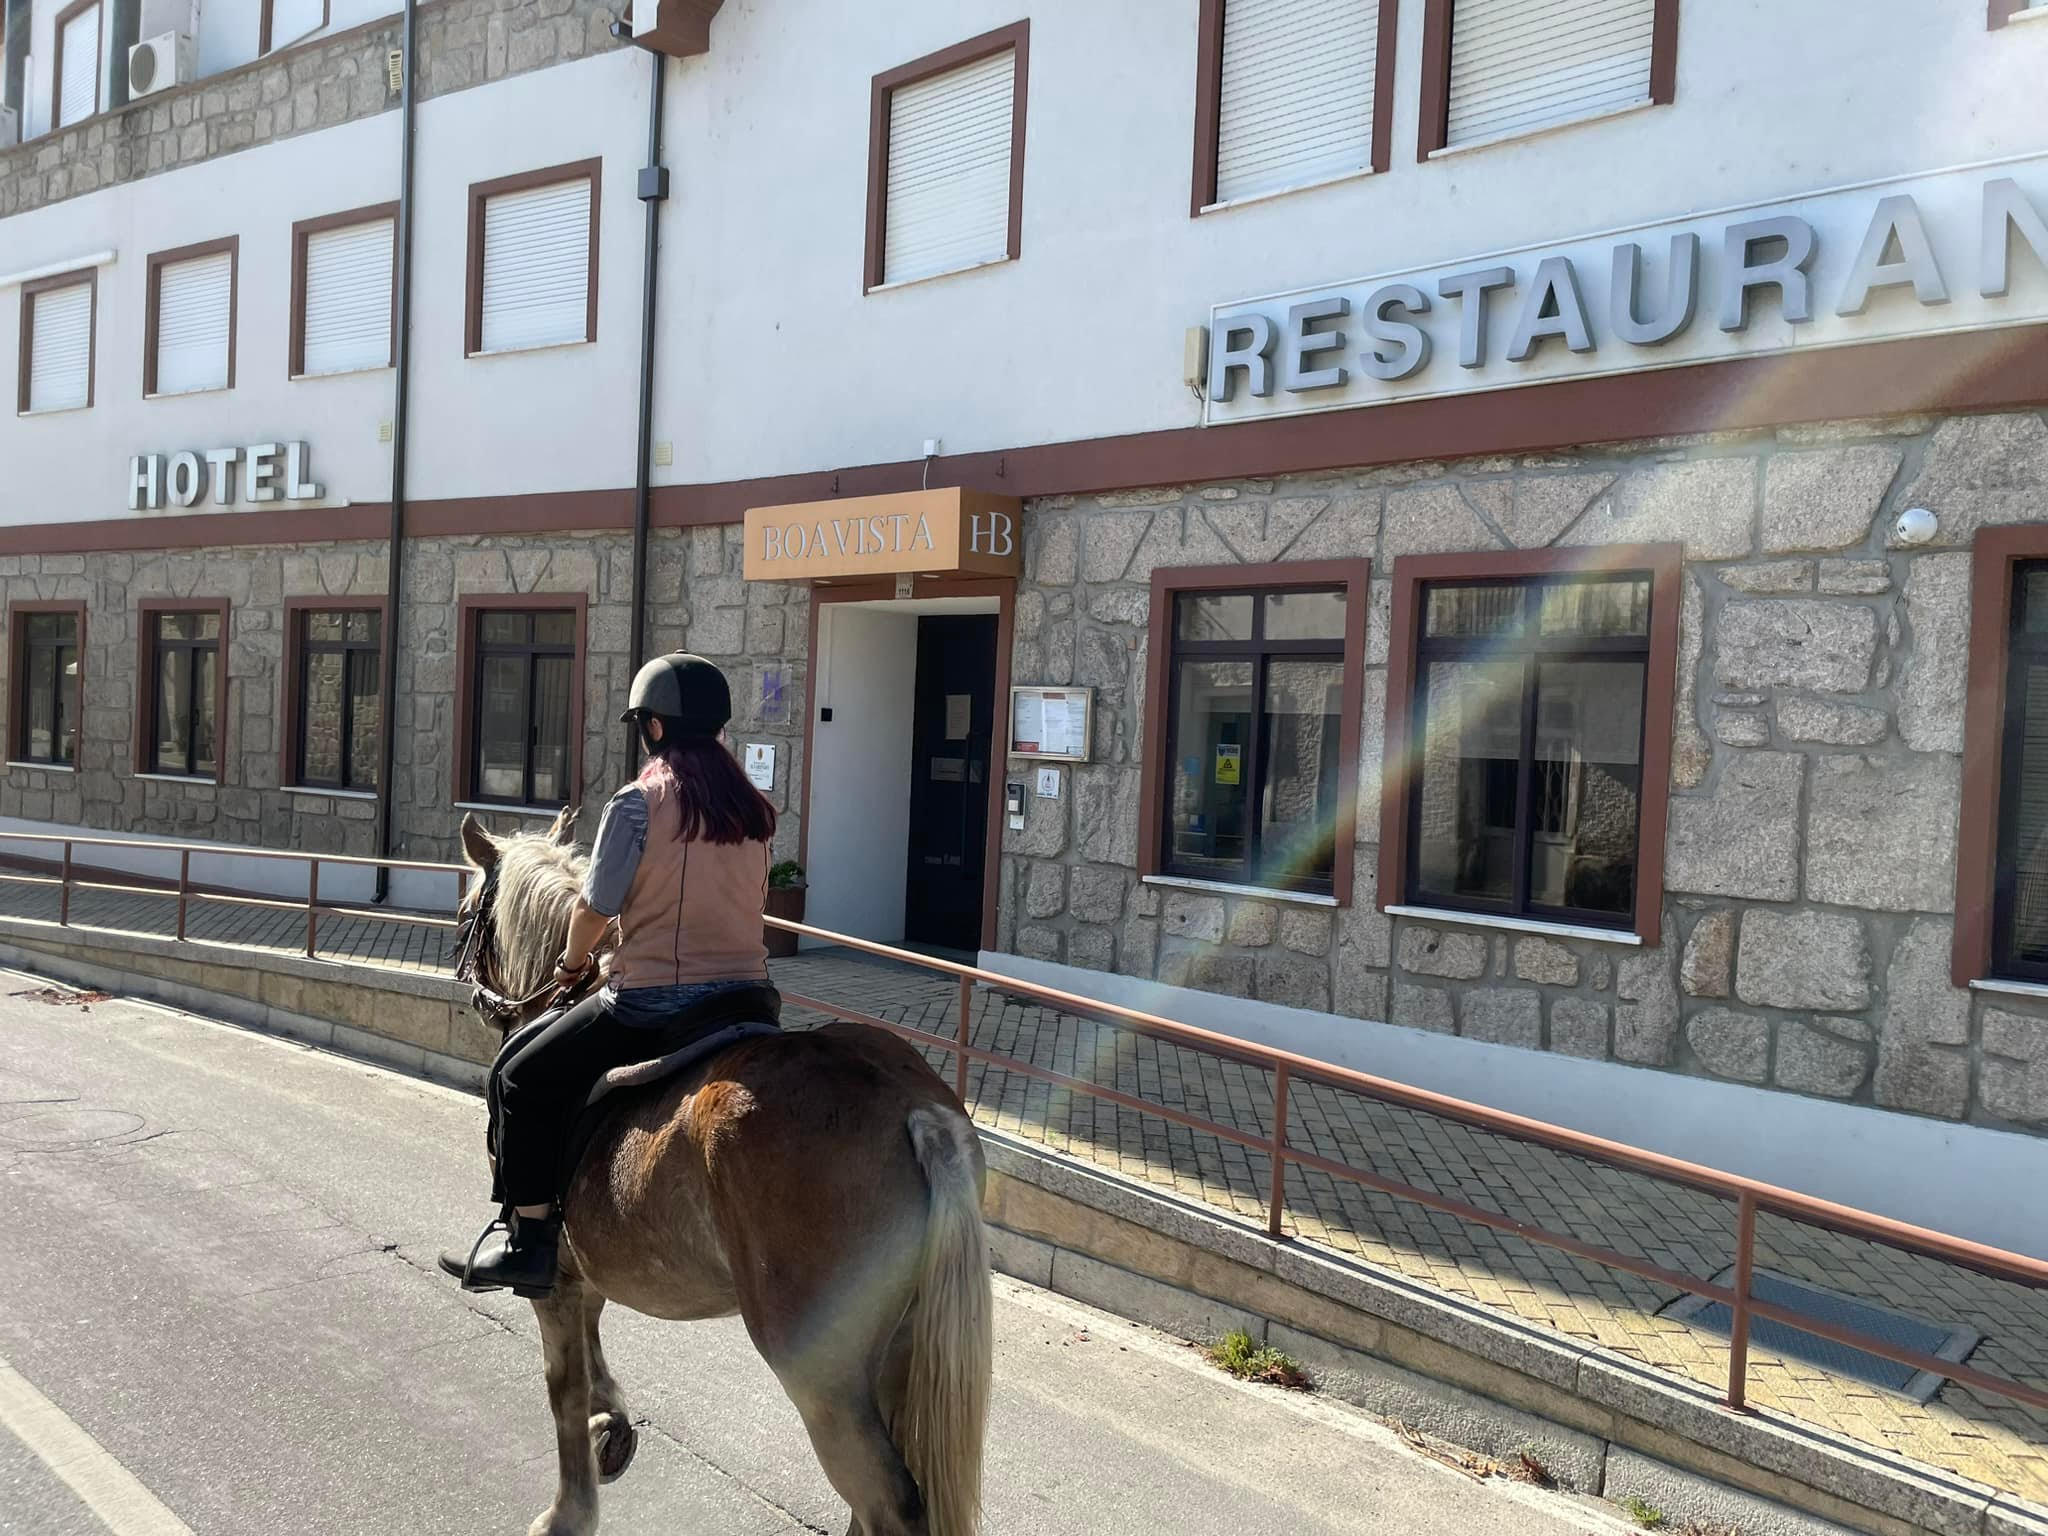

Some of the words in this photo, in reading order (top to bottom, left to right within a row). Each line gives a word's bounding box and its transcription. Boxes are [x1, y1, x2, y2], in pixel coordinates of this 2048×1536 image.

[129, 441, 325, 510] HOTEL
[762, 512, 936, 561] BOAVISTA
[970, 511, 1013, 556] HB
